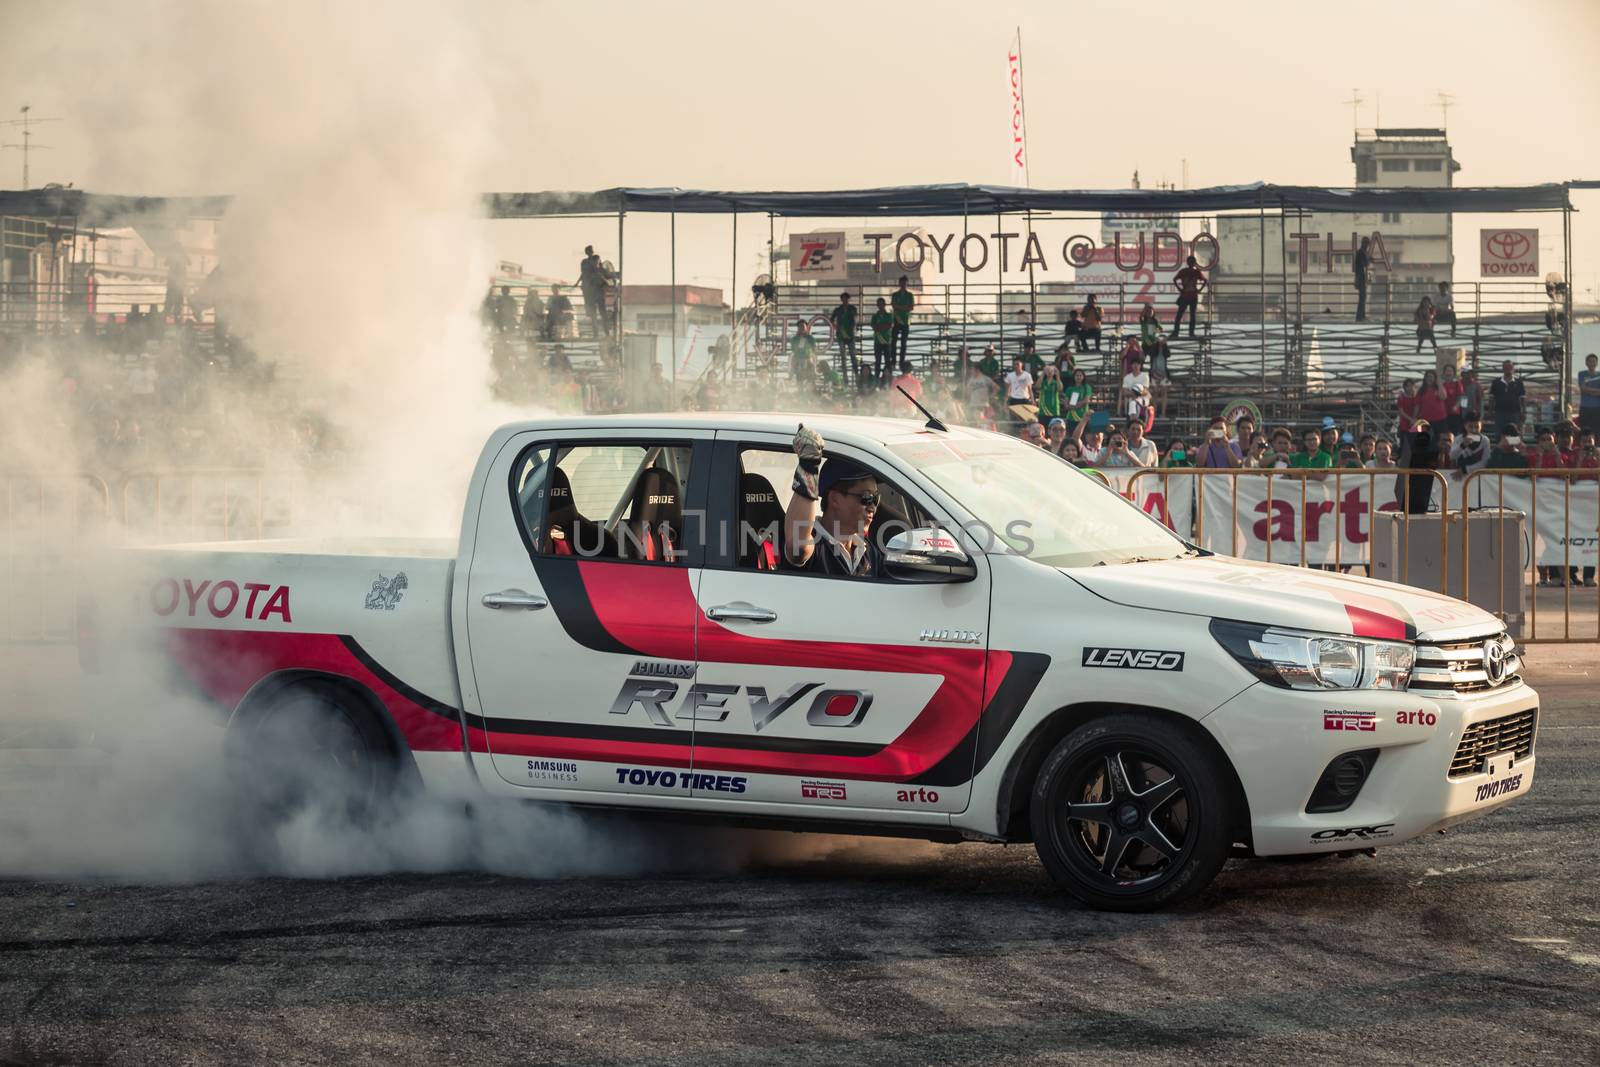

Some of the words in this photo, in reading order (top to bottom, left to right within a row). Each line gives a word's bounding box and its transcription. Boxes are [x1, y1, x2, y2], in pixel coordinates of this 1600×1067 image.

[863, 231, 1048, 273] TOYOTA
[1062, 235, 1095, 268] @
[1482, 263, 1537, 274] TOYOTA
[648, 494, 674, 505] BRIDE
[745, 492, 774, 503] BRIDE
[1252, 483, 1400, 544] art
[148, 579, 292, 622] OYOTA
[920, 628, 983, 644] HILUX
[1084, 648, 1182, 670] LENSO
[631, 661, 695, 679] HILUX
[608, 677, 874, 732] REVO
[1324, 715, 1376, 731] TRD
[1396, 708, 1436, 726] arto
[527, 760, 577, 773] SAMSUNG
[528, 771, 578, 782] BUSINESS
[616, 767, 678, 788] TOYO
[679, 772, 748, 793] TIRES
[802, 786, 846, 800] TRD
[896, 787, 939, 803] arto
[1475, 779, 1499, 802] TOYO
[1499, 774, 1523, 797] TIRES
